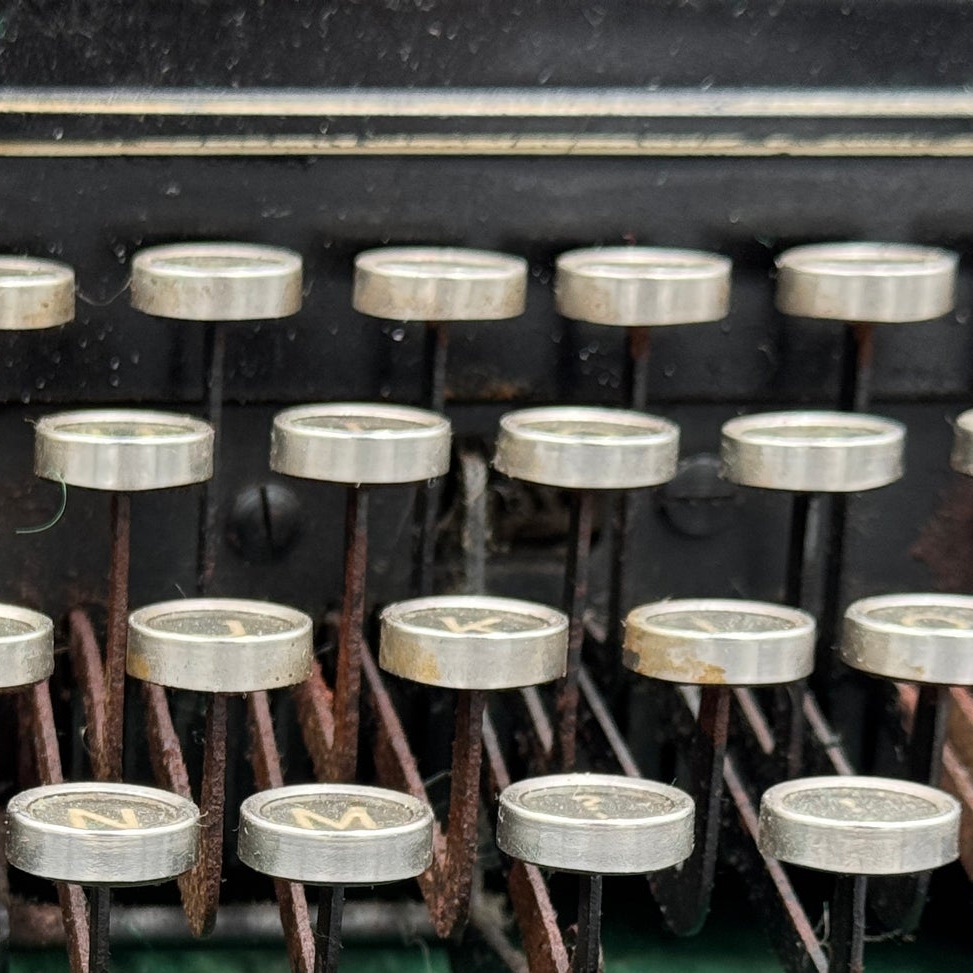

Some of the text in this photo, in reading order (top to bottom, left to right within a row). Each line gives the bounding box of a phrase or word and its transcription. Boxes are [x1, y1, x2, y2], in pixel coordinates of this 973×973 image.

[439, 616, 503, 634] K
[67, 808, 140, 830] N
[291, 806, 378, 830] M
